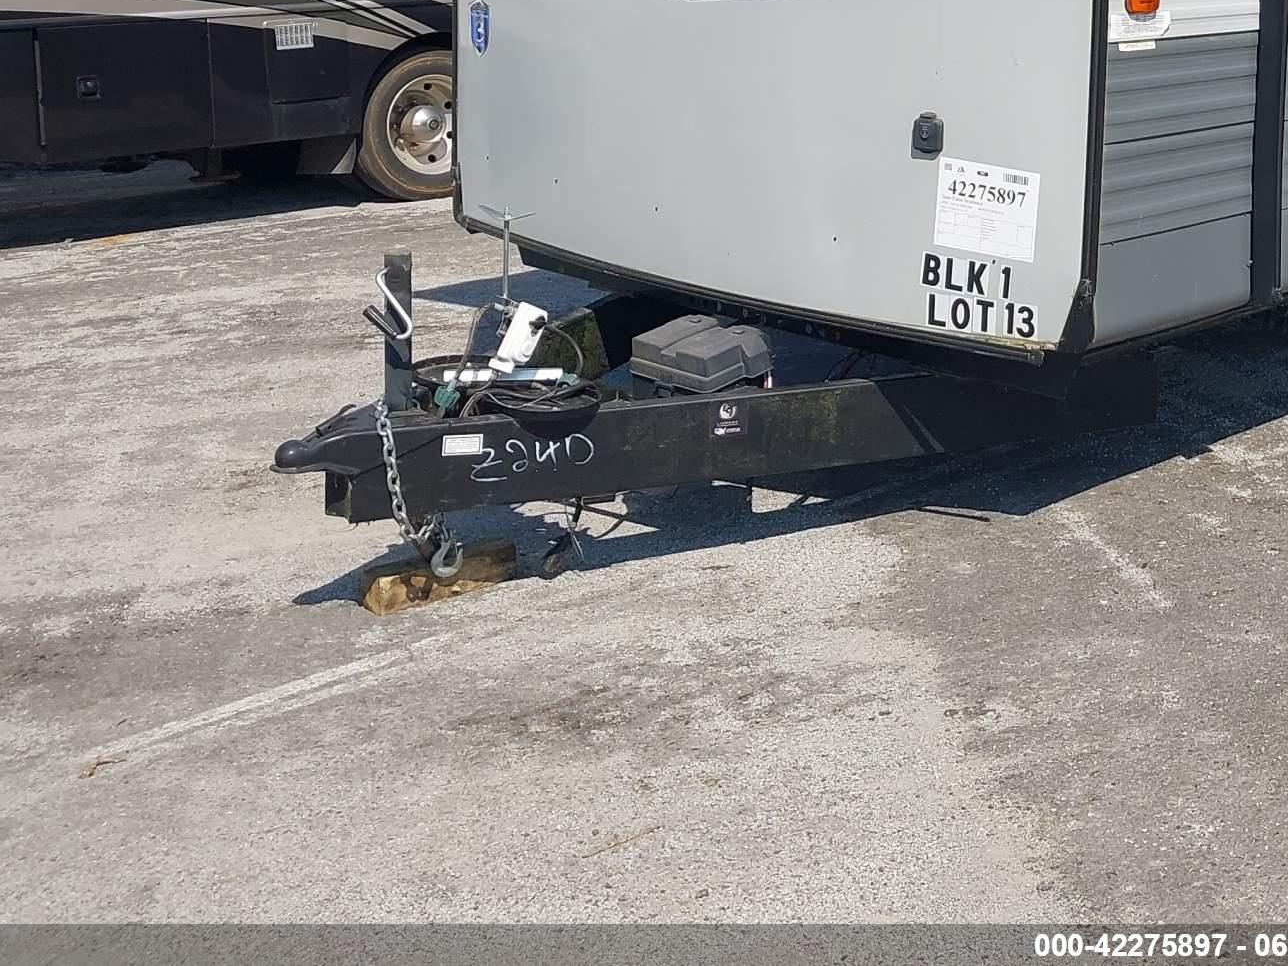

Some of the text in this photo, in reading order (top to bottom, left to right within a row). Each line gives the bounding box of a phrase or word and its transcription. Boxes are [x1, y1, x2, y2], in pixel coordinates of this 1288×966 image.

[948, 179, 1027, 209] 42275897
[921, 252, 1012, 299] BLK 1
[928, 293, 1035, 338] LOT 13
